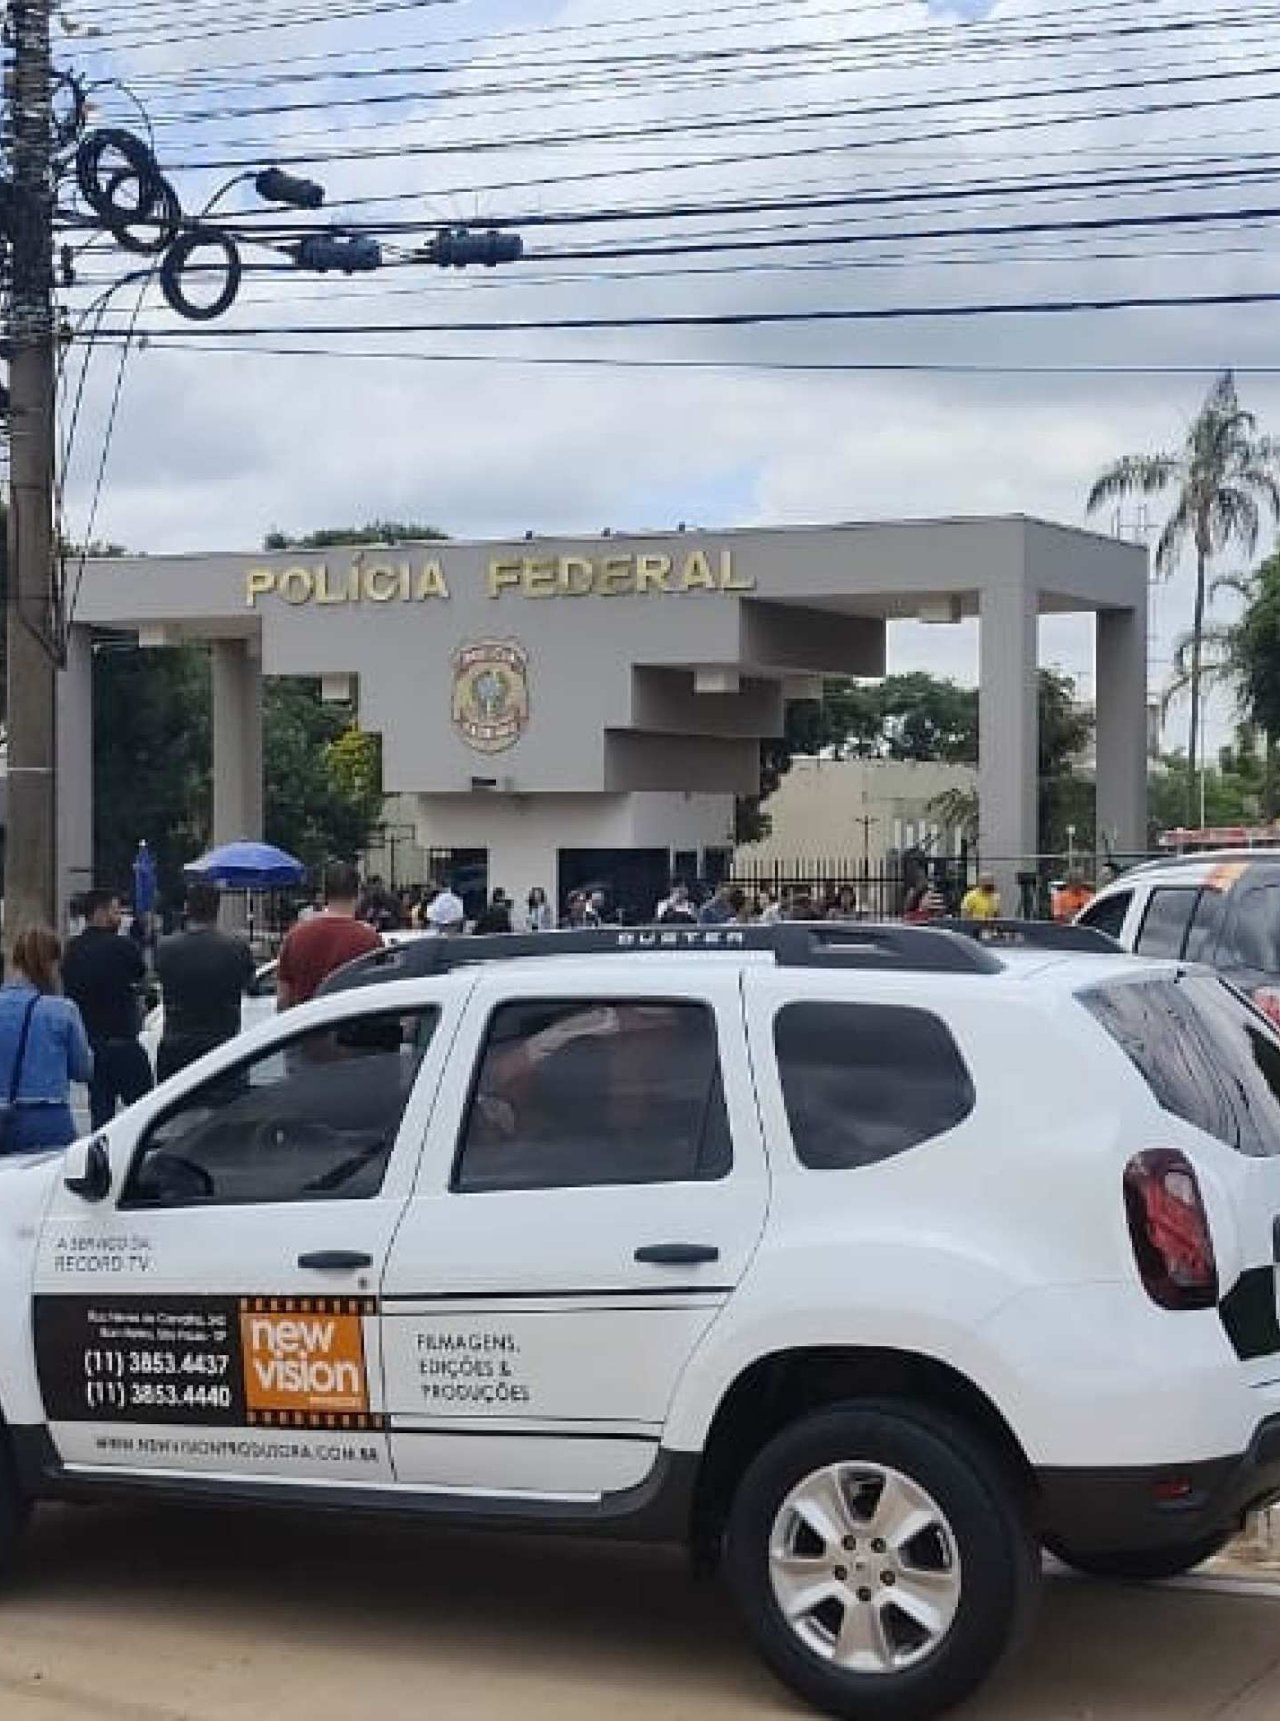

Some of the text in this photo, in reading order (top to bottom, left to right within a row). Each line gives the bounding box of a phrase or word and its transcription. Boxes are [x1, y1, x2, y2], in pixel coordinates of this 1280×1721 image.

[246, 550, 757, 608] POLÍCIA FEDERAL
[617, 931, 744, 946] DUSTER
[55, 1255, 149, 1272] RECORD TV
[252, 1319, 337, 1353] new
[417, 1333, 520, 1352] FILMAGENS,
[84, 1349, 230, 1378] (11) 3853.4437
[253, 1352, 359, 1393] vision
[420, 1355, 512, 1379] EDIÇÕES &
[87, 1381, 231, 1408] (11) 3853.4440
[421, 1381, 531, 1404] PRODUÇÕES
